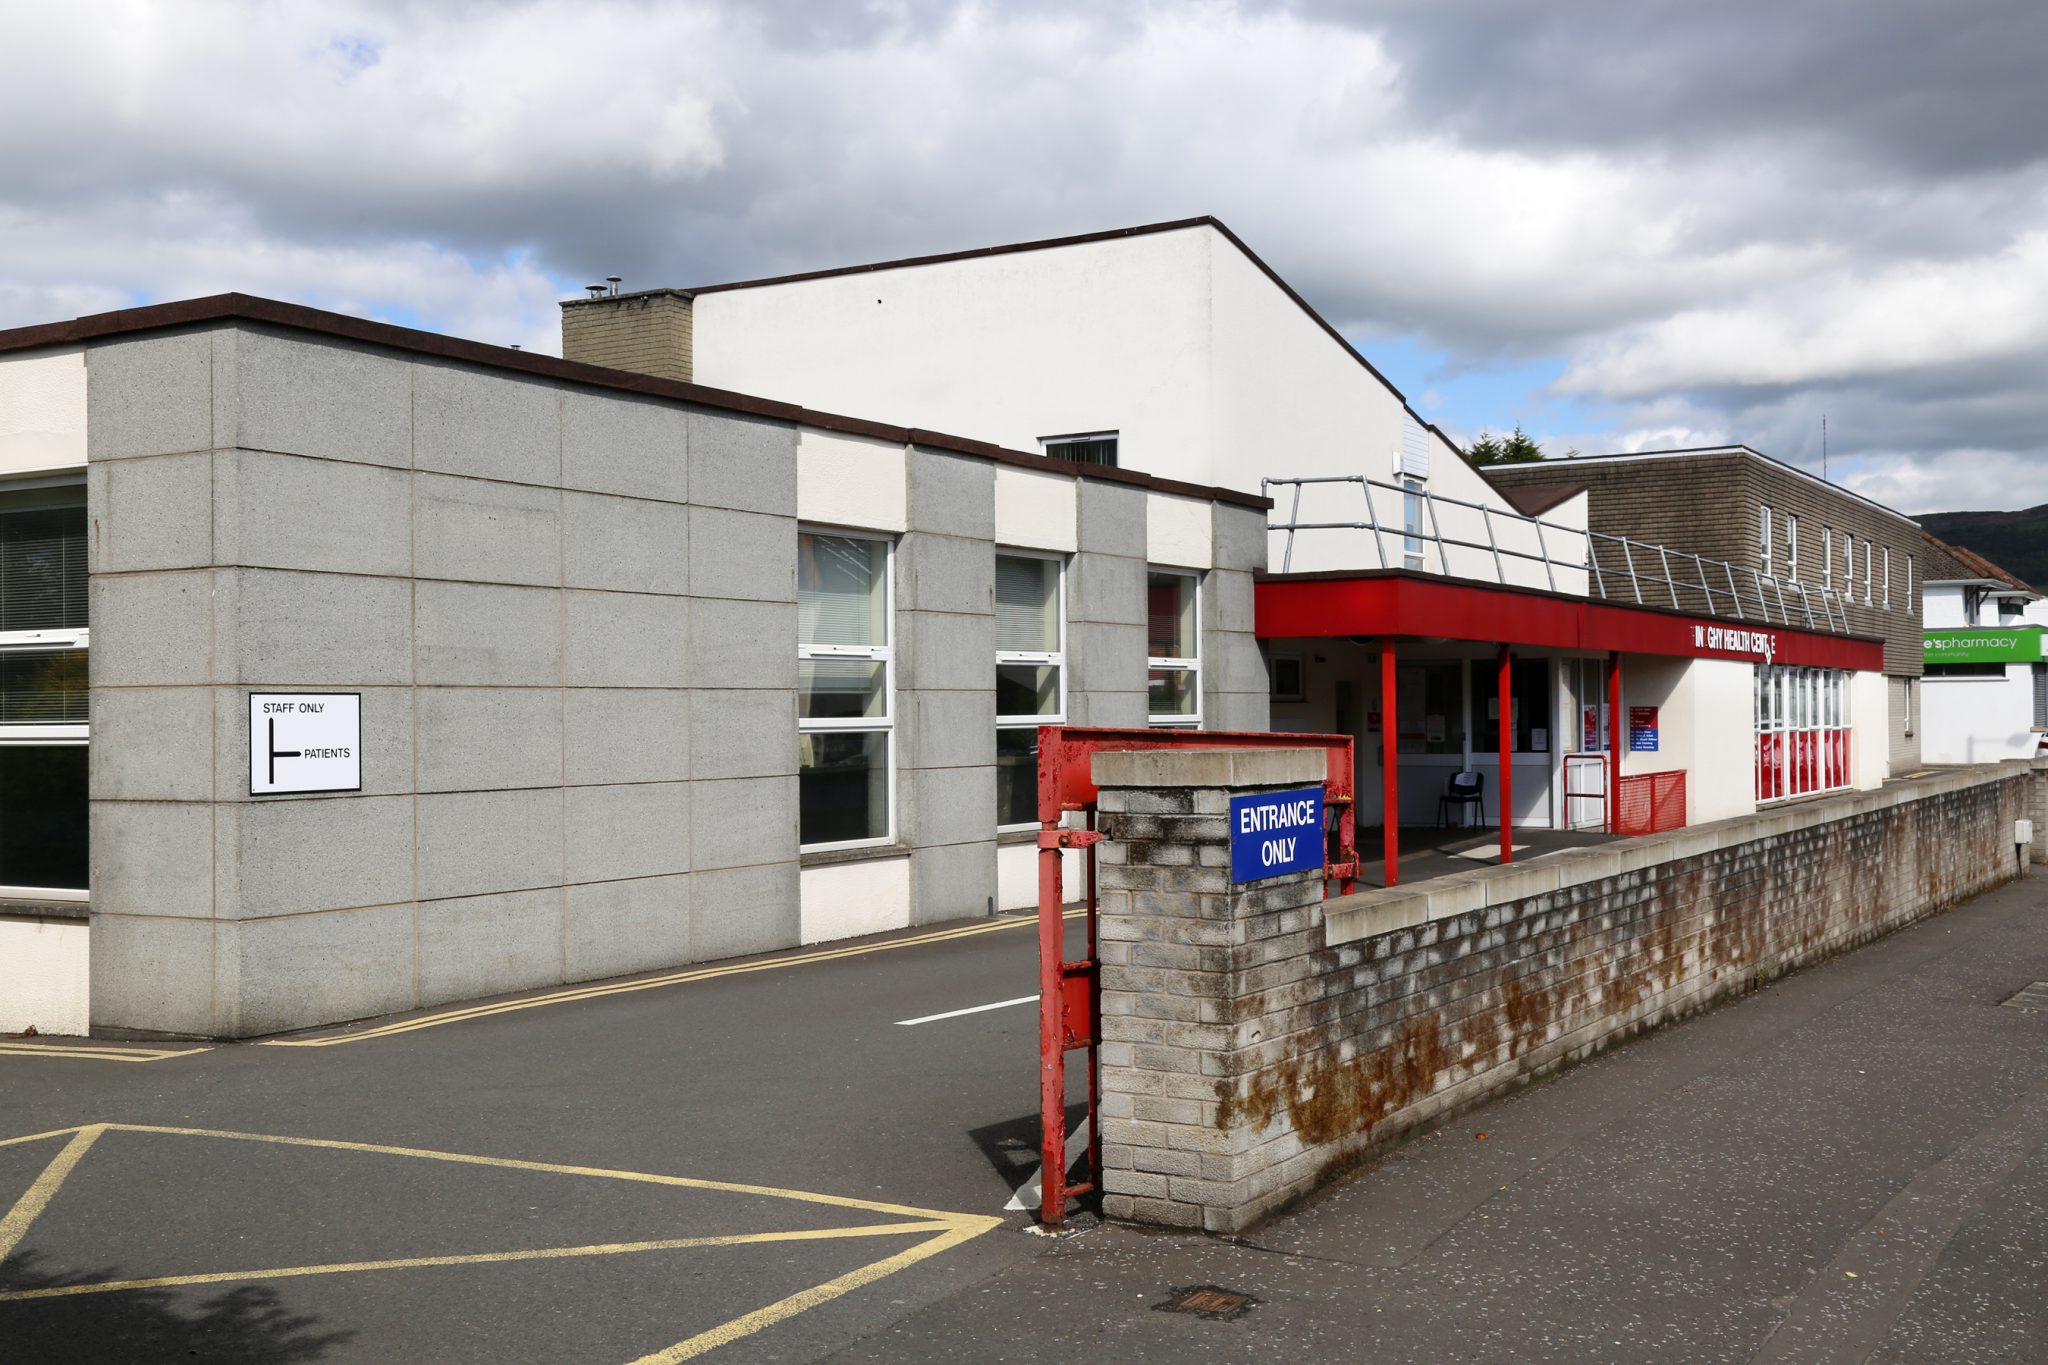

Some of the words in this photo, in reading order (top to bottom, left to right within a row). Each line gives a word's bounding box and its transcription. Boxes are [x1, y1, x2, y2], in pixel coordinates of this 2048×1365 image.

[1724, 628, 1751, 652] HEALTH
[263, 702, 295, 713] STAFF
[299, 702, 325, 713] ONLY
[304, 748, 351, 759] PATIENTS
[1240, 799, 1315, 834] ENTRANCE
[1261, 836, 1297, 867] ONLY
